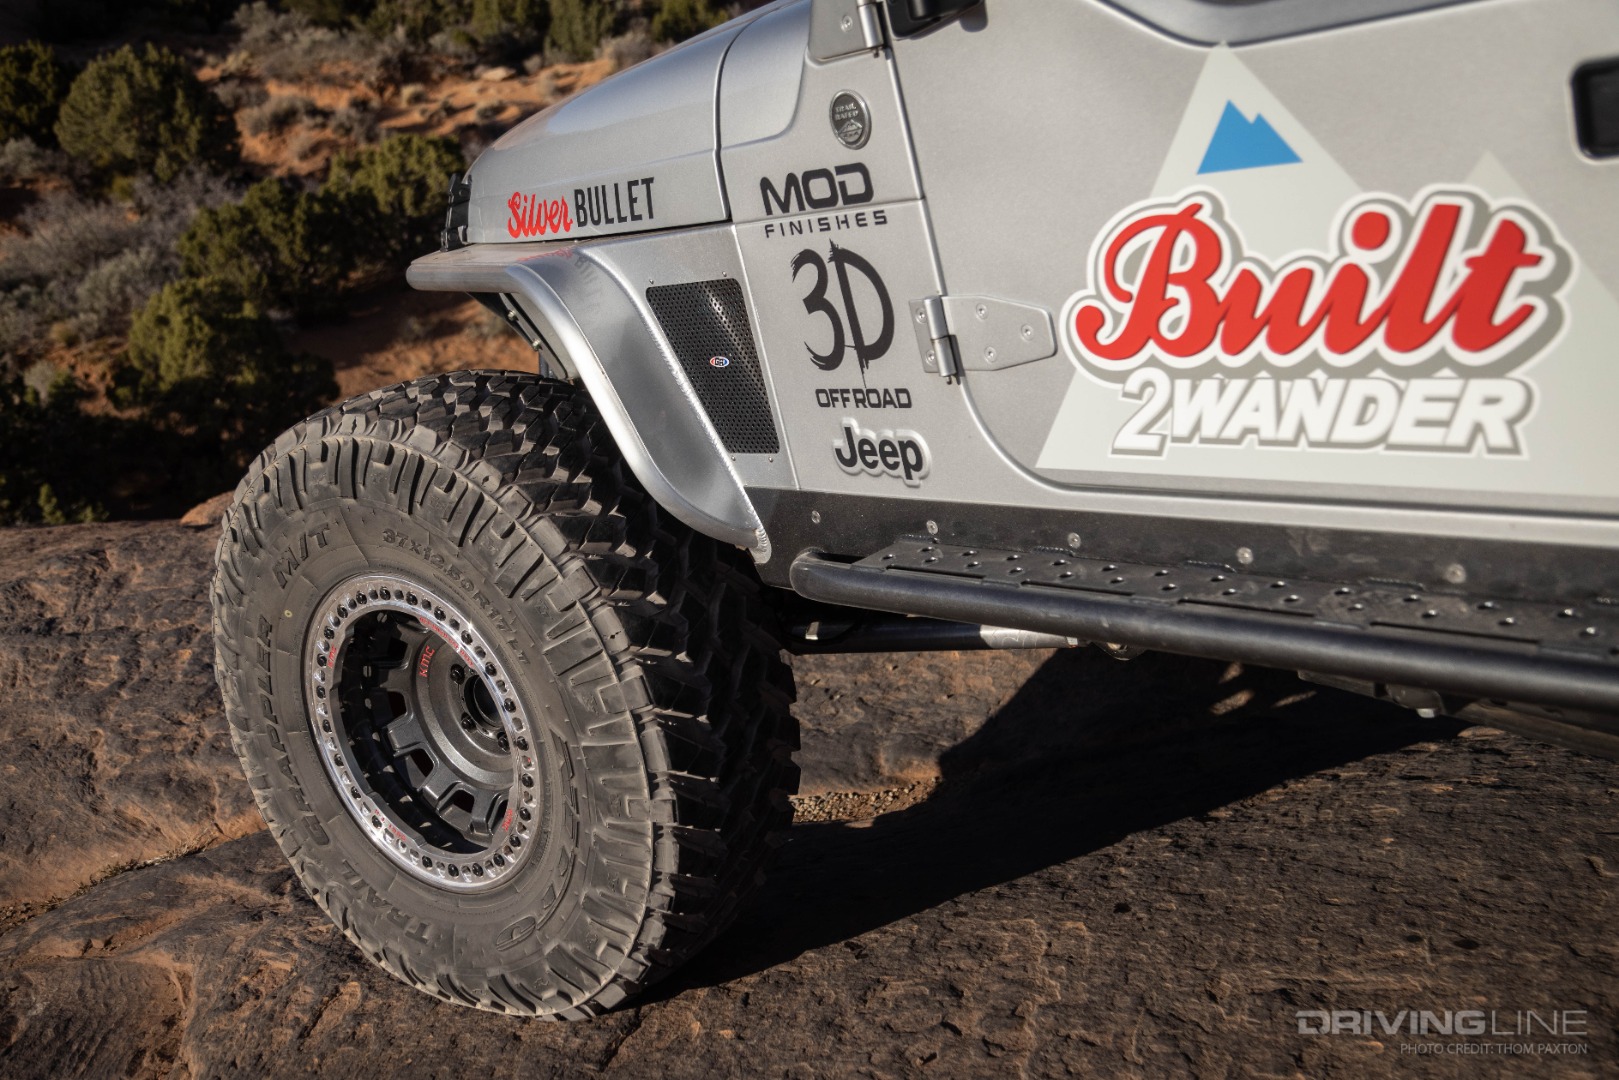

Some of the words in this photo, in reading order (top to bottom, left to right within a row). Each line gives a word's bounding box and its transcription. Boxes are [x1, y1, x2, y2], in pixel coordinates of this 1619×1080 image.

[507, 191, 573, 239] Silver
[574, 176, 655, 228] BULLET
[760, 162, 874, 215] MOD
[765, 209, 888, 238] FINISHES
[790, 238, 895, 388] 3D
[1075, 202, 1543, 361] Built
[1109, 367, 1526, 459] 2WANDER
[833, 425, 924, 481] Jeep
